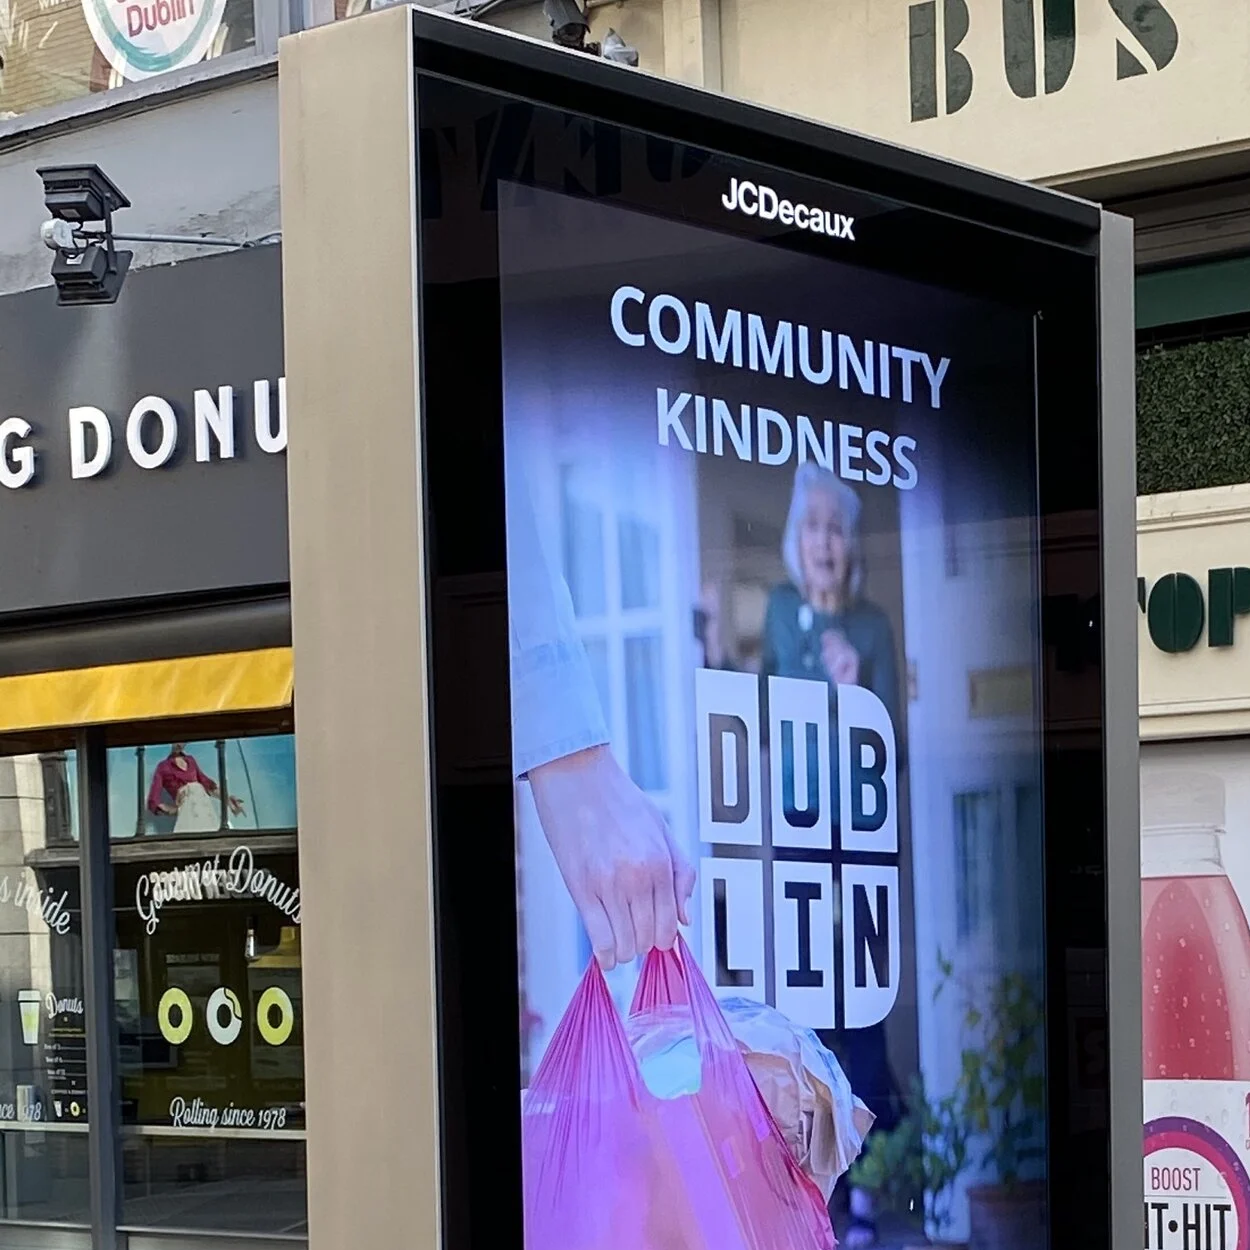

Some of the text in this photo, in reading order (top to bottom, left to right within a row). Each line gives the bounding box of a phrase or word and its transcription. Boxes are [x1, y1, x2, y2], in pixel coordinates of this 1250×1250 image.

[909, 0, 1180, 122] BUS
[721, 177, 856, 240] JCDecaux
[610, 285, 951, 409] COMMUNITY
[656, 387, 919, 490] KINDNESS
[15, 872, 71, 935] inside
[136, 854, 221, 935] Gourmet
[45, 992, 83, 1019] Donuts
[169, 1096, 286, 1130] Rolling since 1978
[1151, 1167, 1201, 1192] BOOST
